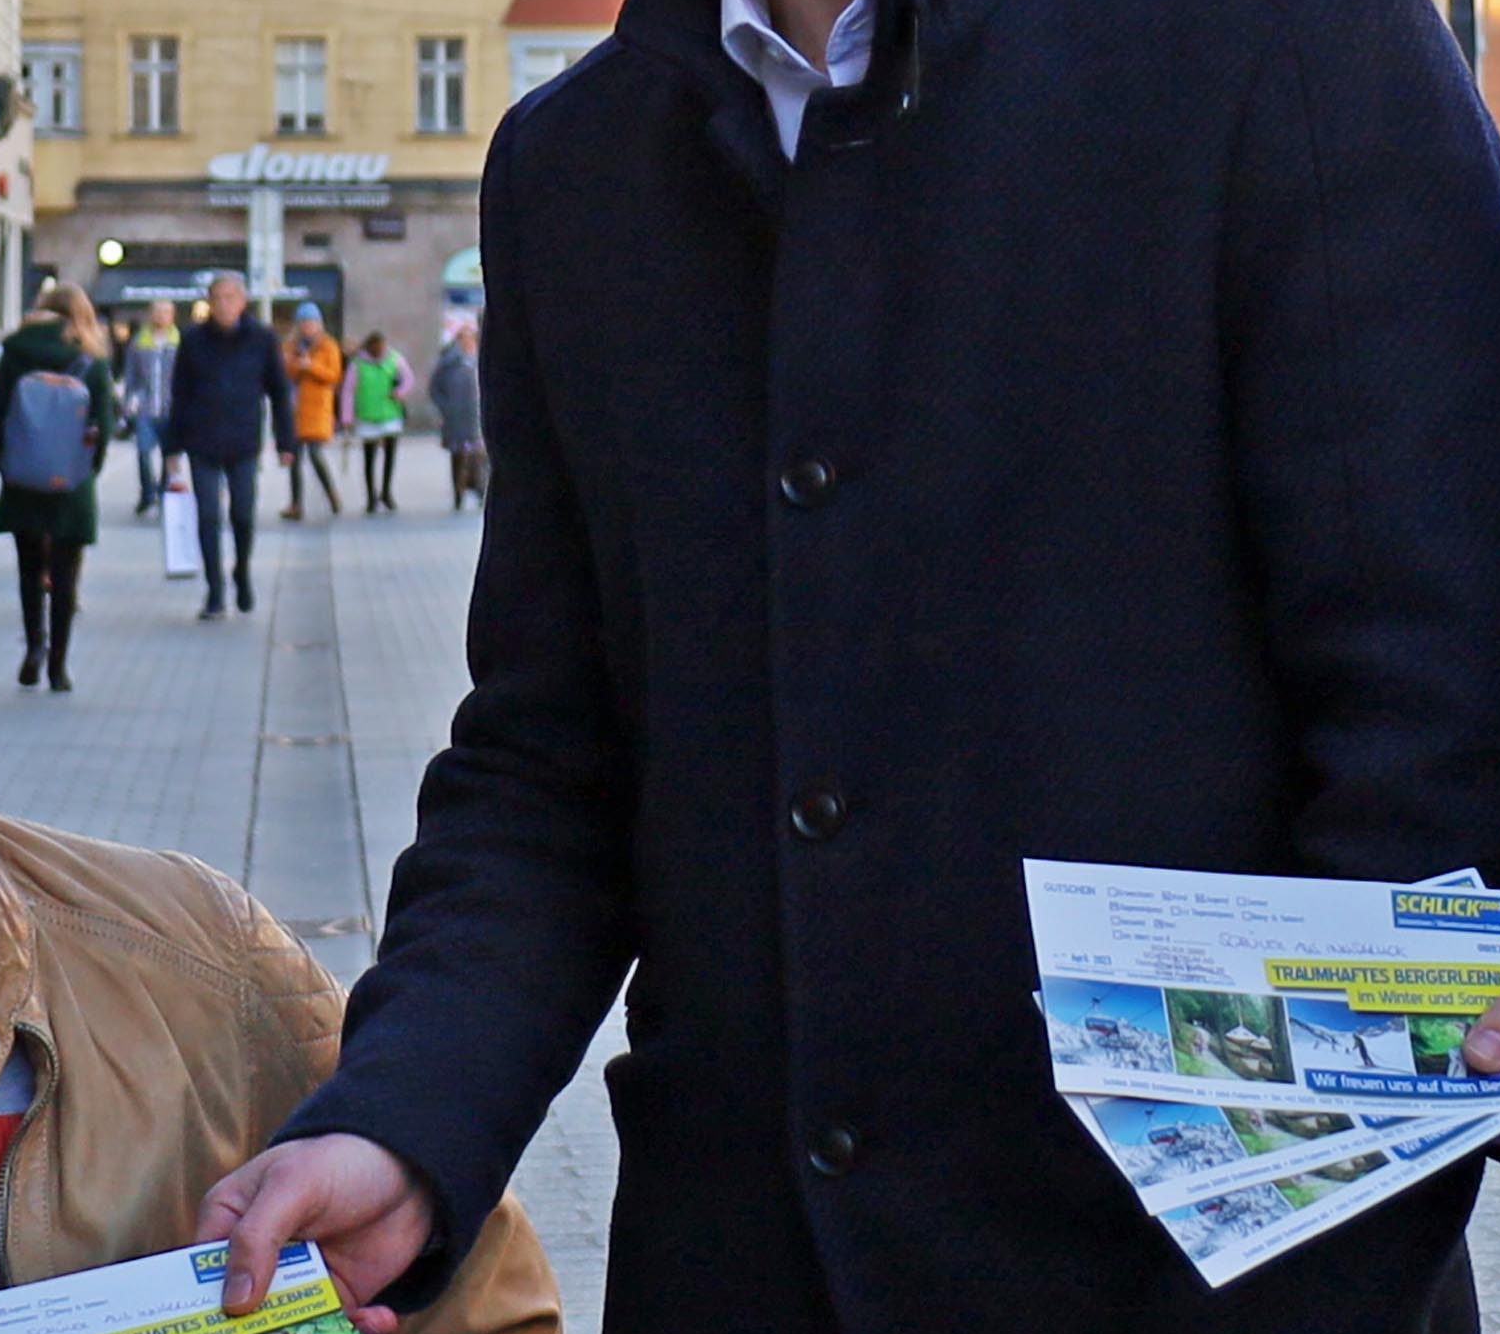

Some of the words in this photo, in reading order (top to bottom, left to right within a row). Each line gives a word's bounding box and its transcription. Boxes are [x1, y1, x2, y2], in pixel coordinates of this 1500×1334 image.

[1397, 894, 1480, 917] SCHLICK
[1271, 965, 1390, 983] TRAUMHAFTES
[1378, 991, 1422, 1006] Winter
[1428, 993, 1454, 1006] und
[1311, 1071, 1338, 1088] Wir
[1341, 1074, 1385, 1091] freuen
[1388, 1081, 1413, 1093] uns
[1416, 1078, 1439, 1094] auf
[1441, 1078, 1478, 1094] Ihren
[242, 1317, 268, 1331] und
[271, 1299, 328, 1322] Sommer
